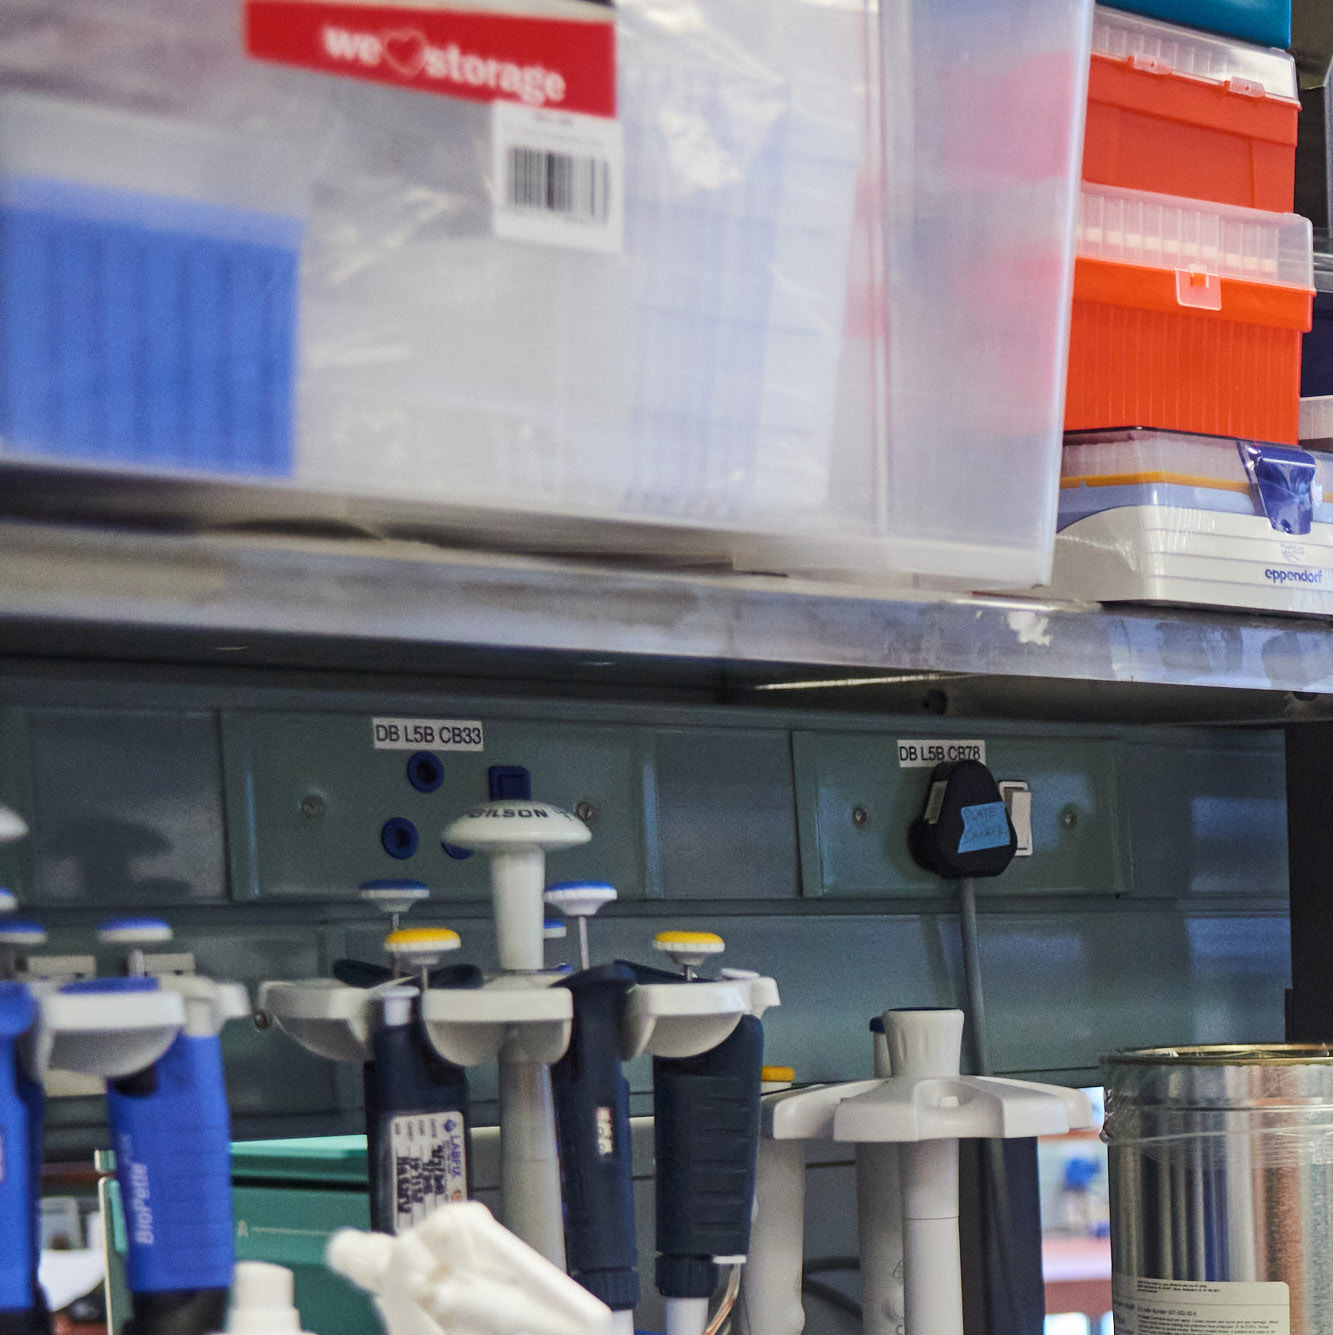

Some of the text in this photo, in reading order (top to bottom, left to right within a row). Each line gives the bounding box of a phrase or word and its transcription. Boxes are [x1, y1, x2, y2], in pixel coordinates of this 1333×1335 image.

[323, 25, 567, 108] we storage
[1264, 568, 1322, 584] eppendorf
[375, 724, 482, 745] DB L5B CB33
[899, 745, 981, 762] DB L5B CB78
